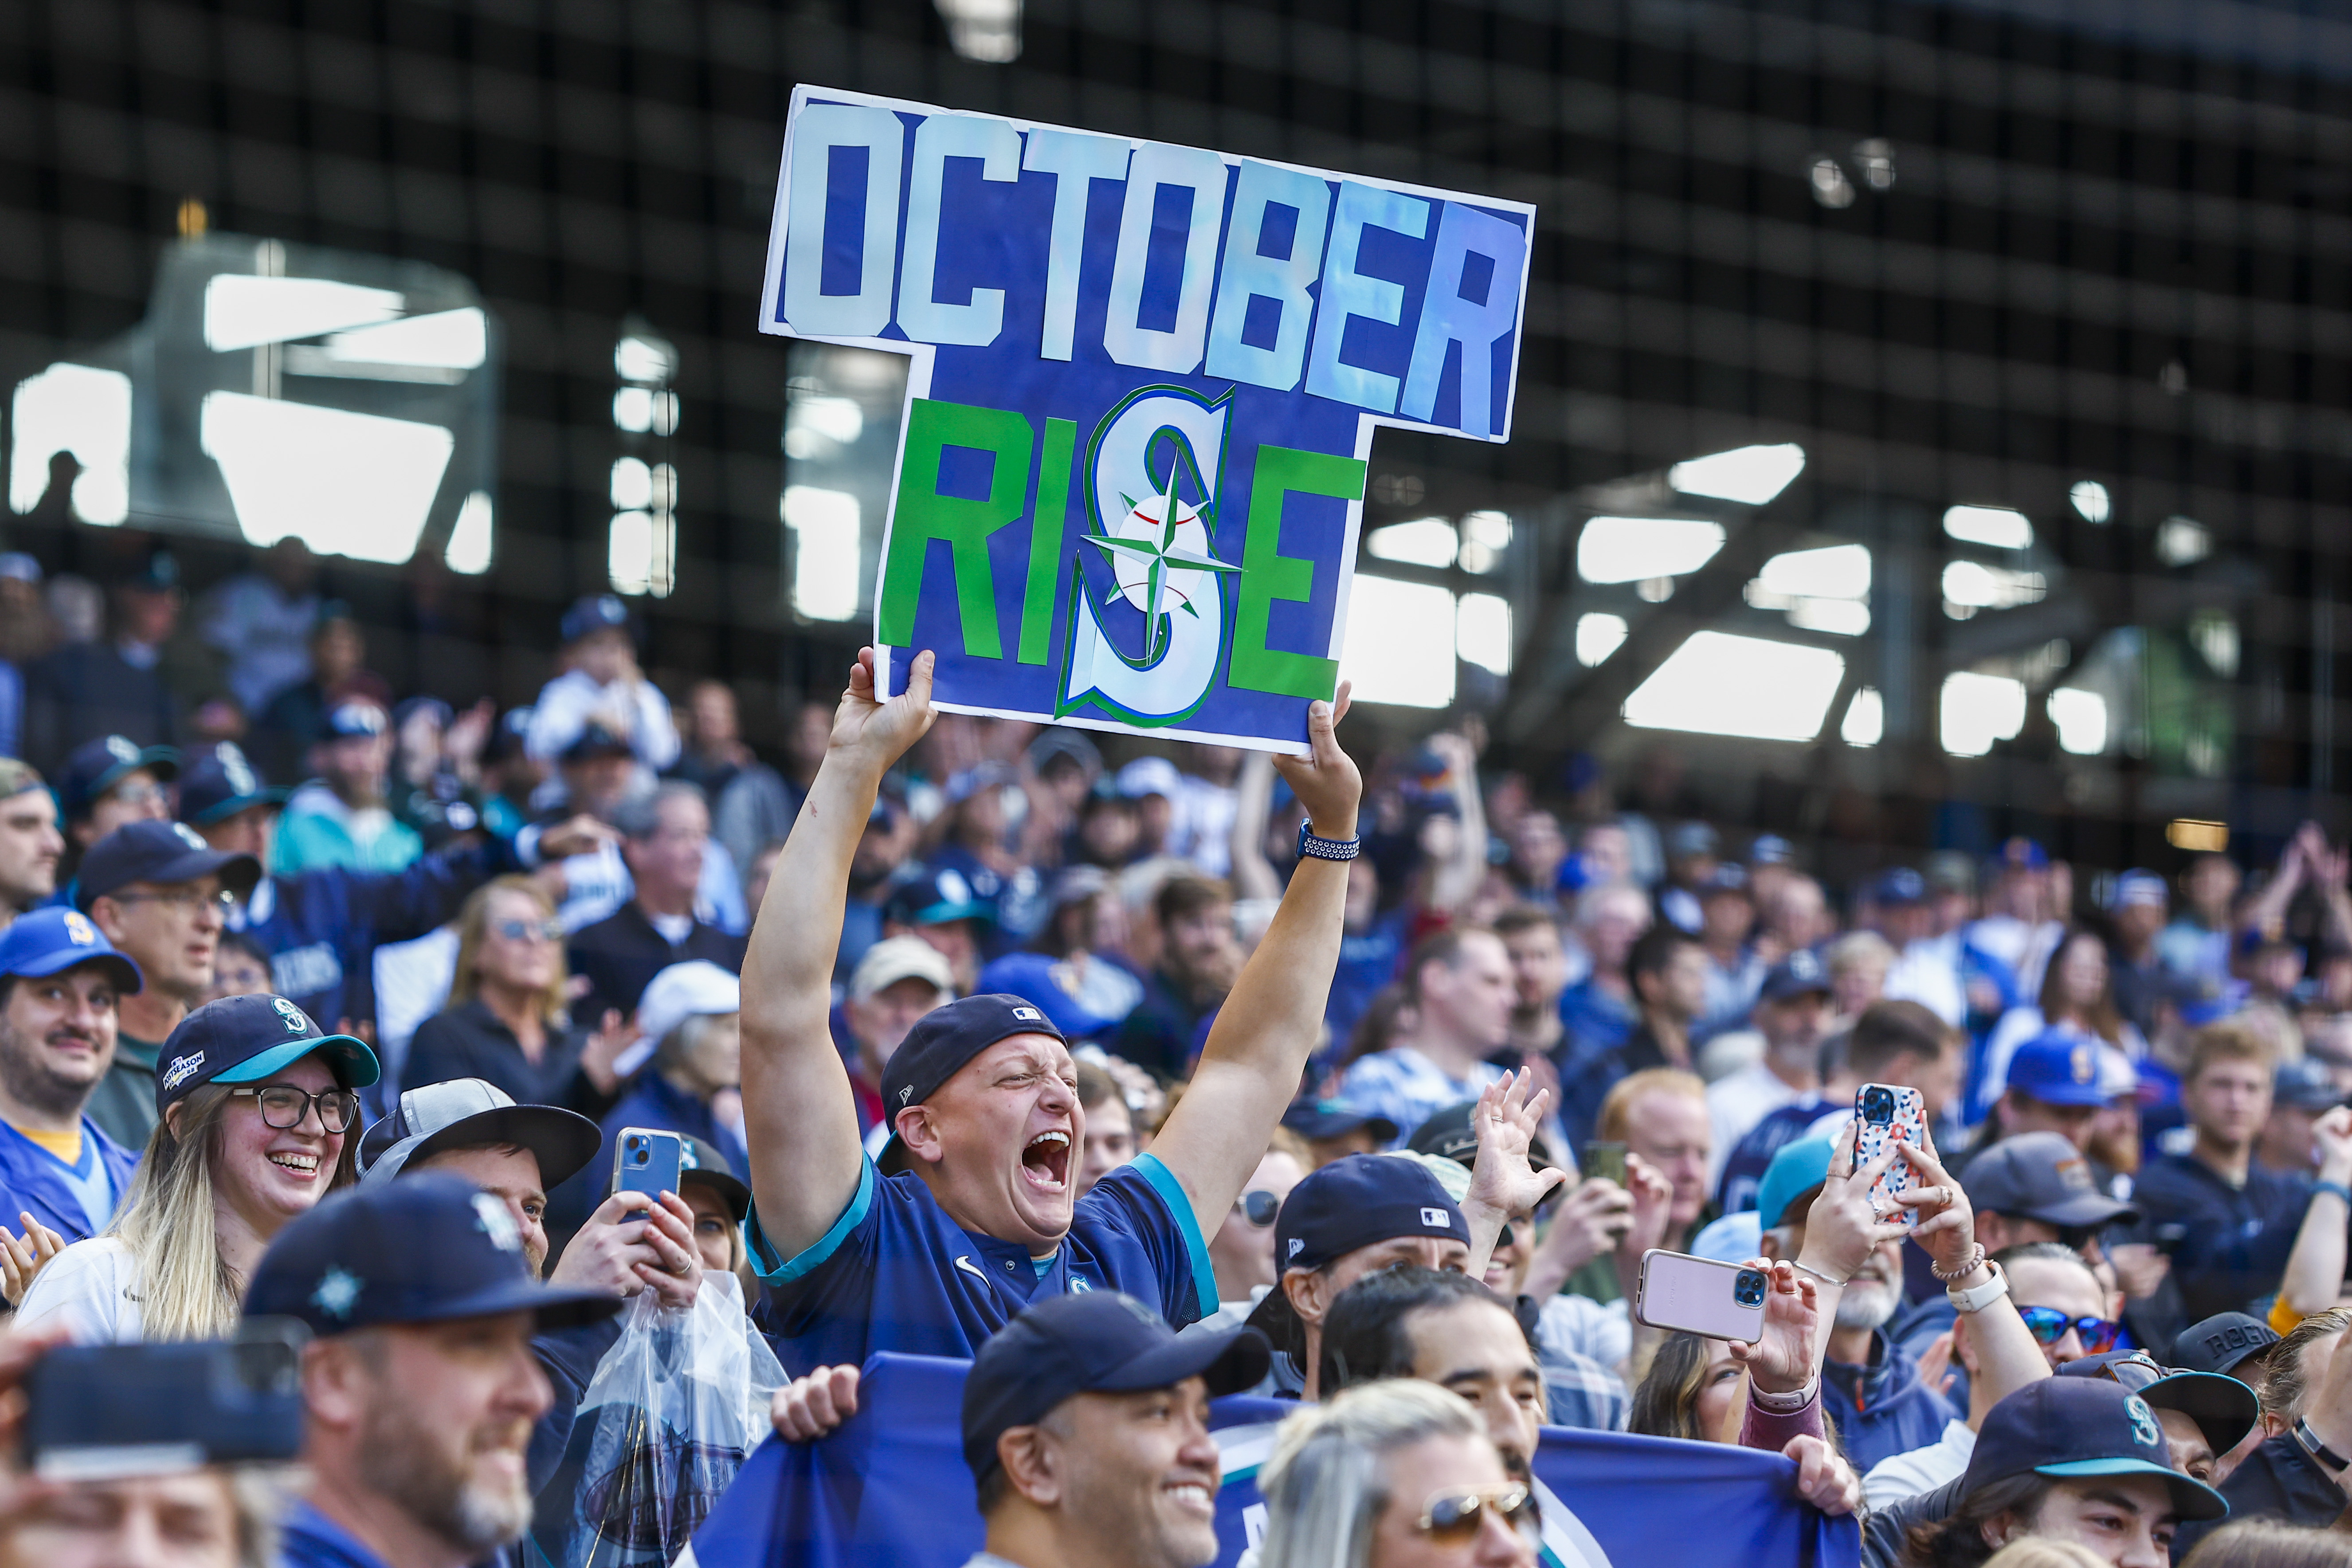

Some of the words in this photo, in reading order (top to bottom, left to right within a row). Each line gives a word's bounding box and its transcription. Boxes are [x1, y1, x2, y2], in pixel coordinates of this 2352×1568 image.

[784, 103, 1527, 440] OCTOBER
[878, 383, 1368, 729] RISE
[164, 1054, 202, 1087] POSTSEASON
[270, 997, 308, 1034] S
